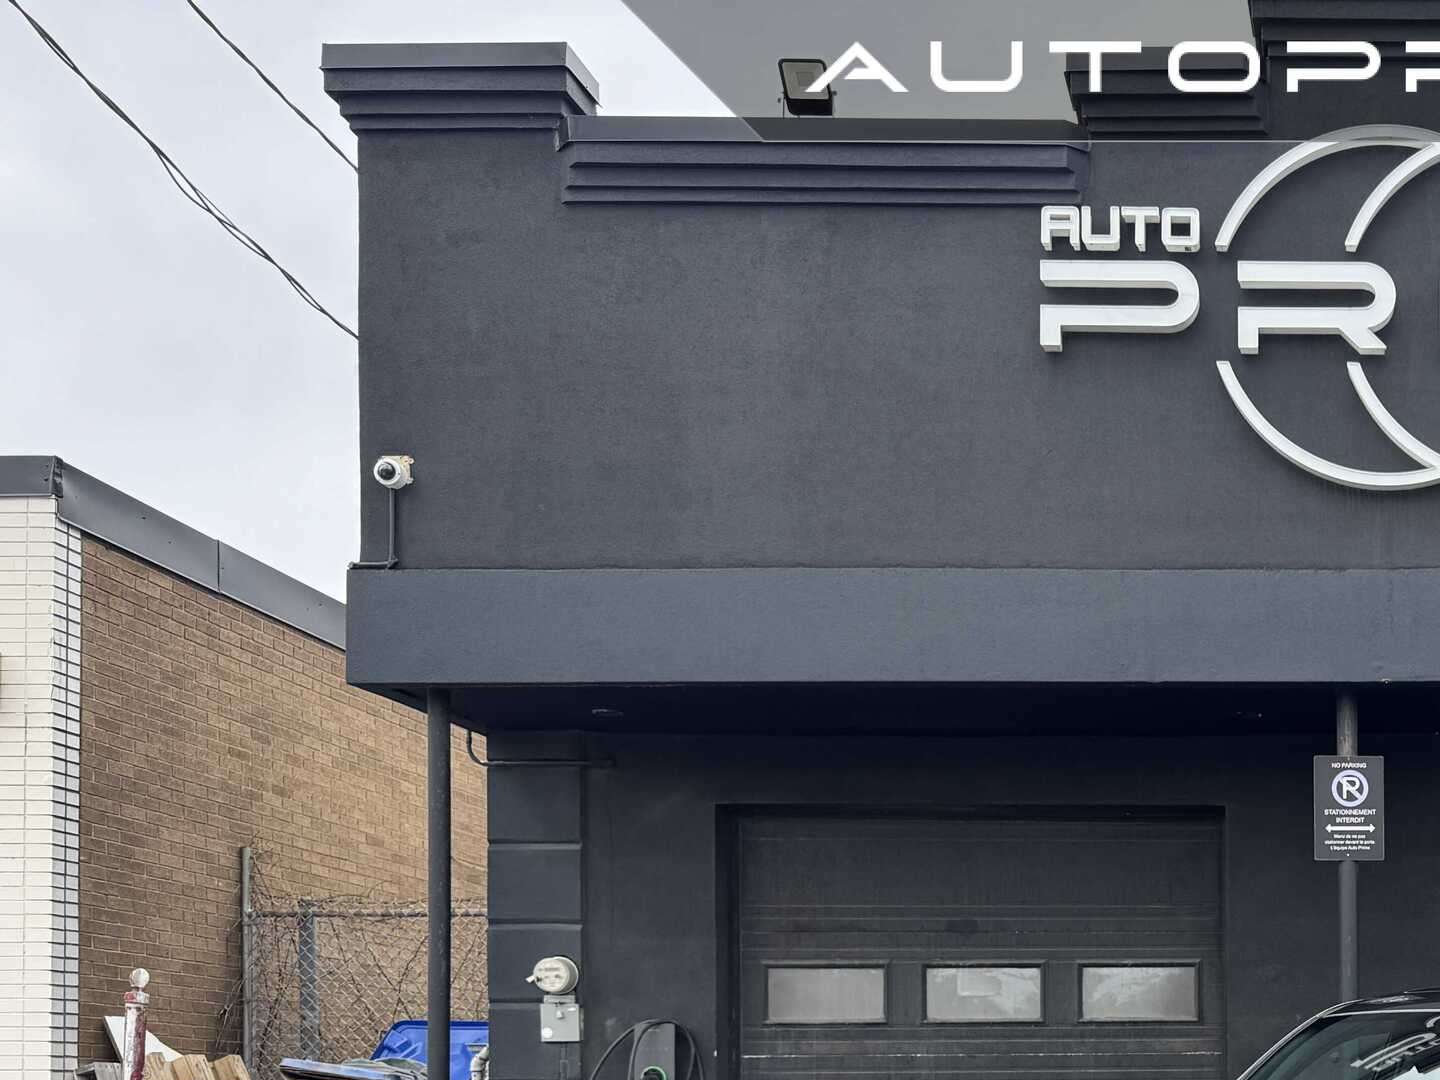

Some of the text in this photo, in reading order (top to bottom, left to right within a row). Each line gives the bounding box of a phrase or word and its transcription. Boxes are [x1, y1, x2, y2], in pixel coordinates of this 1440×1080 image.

[1040, 206, 1200, 252] AUTO
[1324, 808, 1376, 816] STATIONNEMENT
[1335, 816, 1365, 824] INTERDIT
